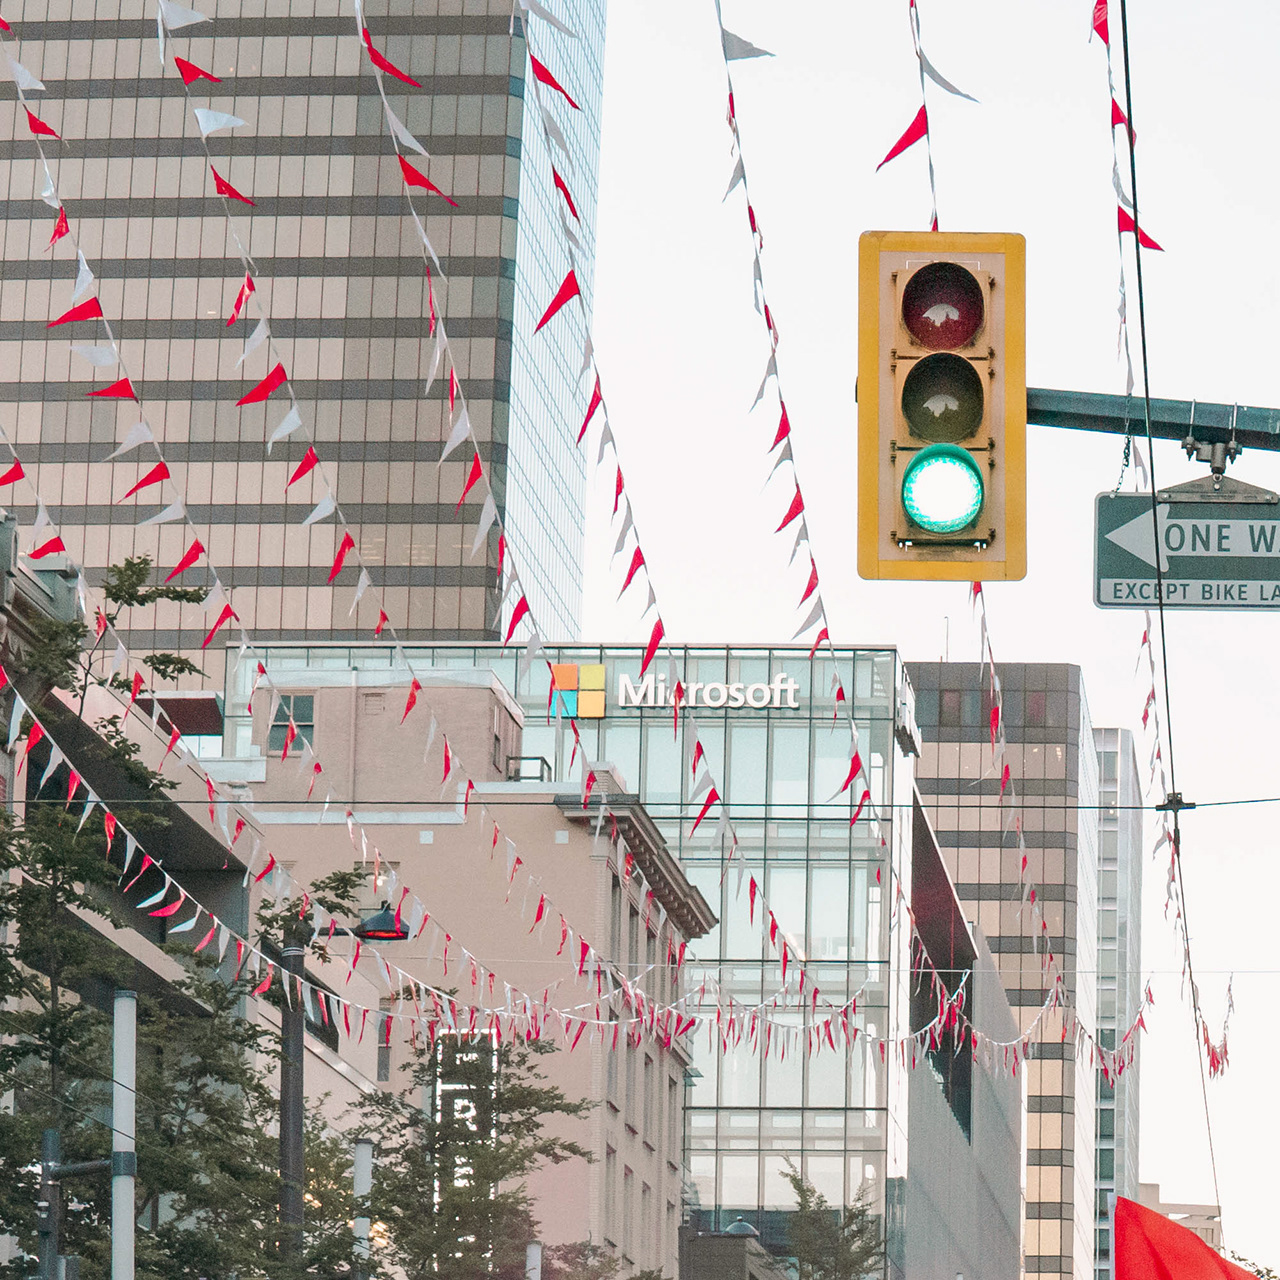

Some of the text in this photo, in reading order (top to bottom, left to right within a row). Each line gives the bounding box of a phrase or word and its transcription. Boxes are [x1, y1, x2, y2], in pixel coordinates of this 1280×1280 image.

[1164, 523, 1231, 552] ONE
[1113, 582, 1190, 600] EXCEPT
[1201, 583, 1248, 601] BIKE
